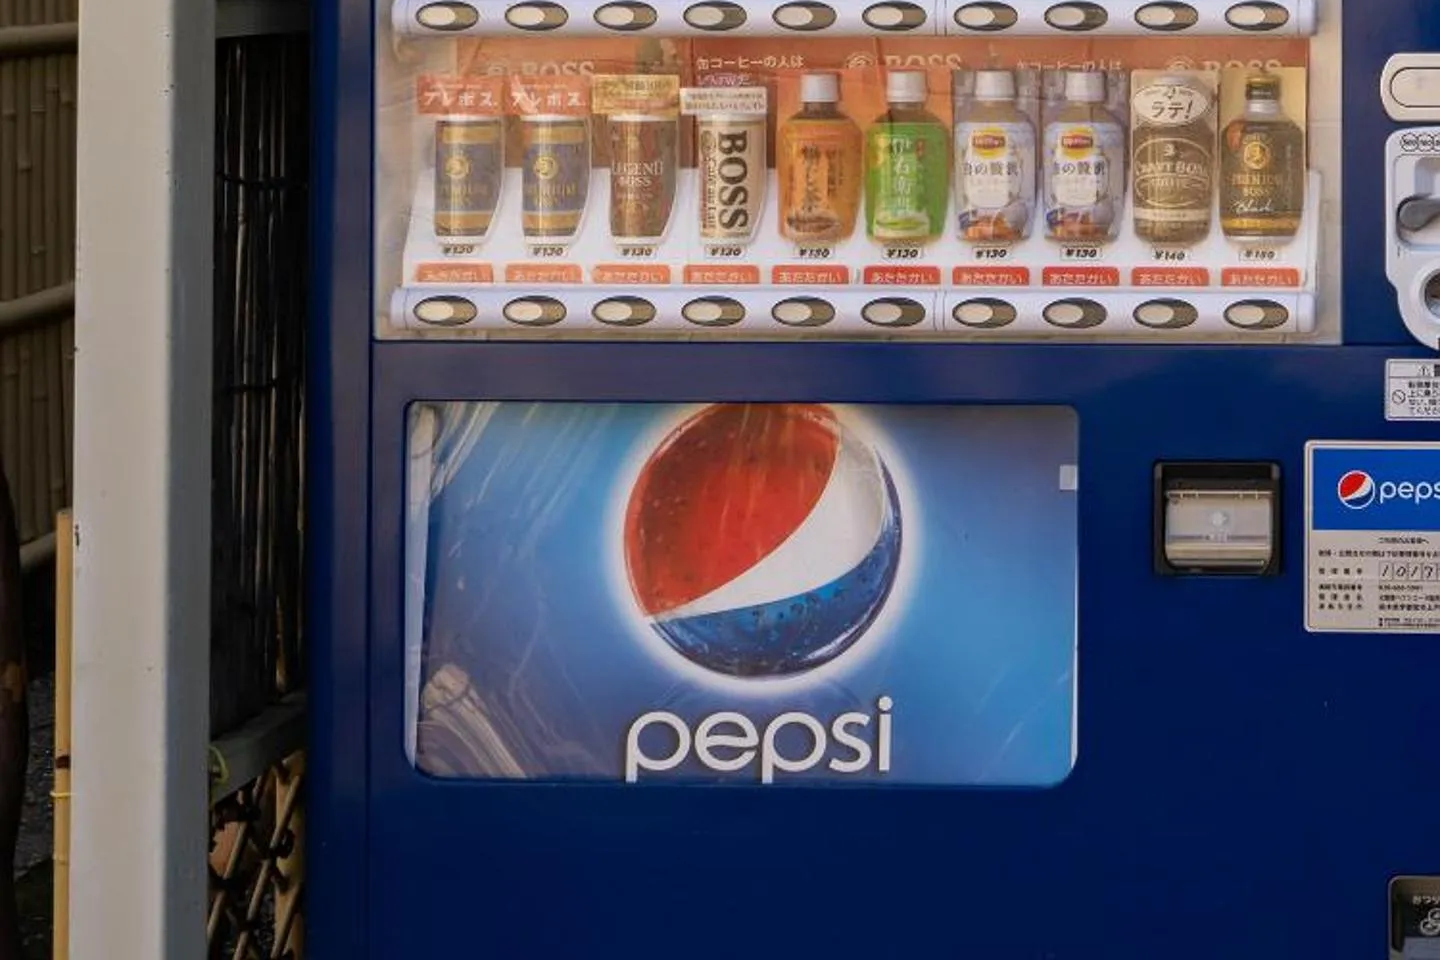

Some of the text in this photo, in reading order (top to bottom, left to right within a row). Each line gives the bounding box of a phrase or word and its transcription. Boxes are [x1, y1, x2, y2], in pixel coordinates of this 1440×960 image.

[1151, 99, 1194, 120] ラテ!
[718, 130, 749, 230] BOSS
[976, 249, 1007, 258] ¥130
[625, 695, 893, 785] pepsi
